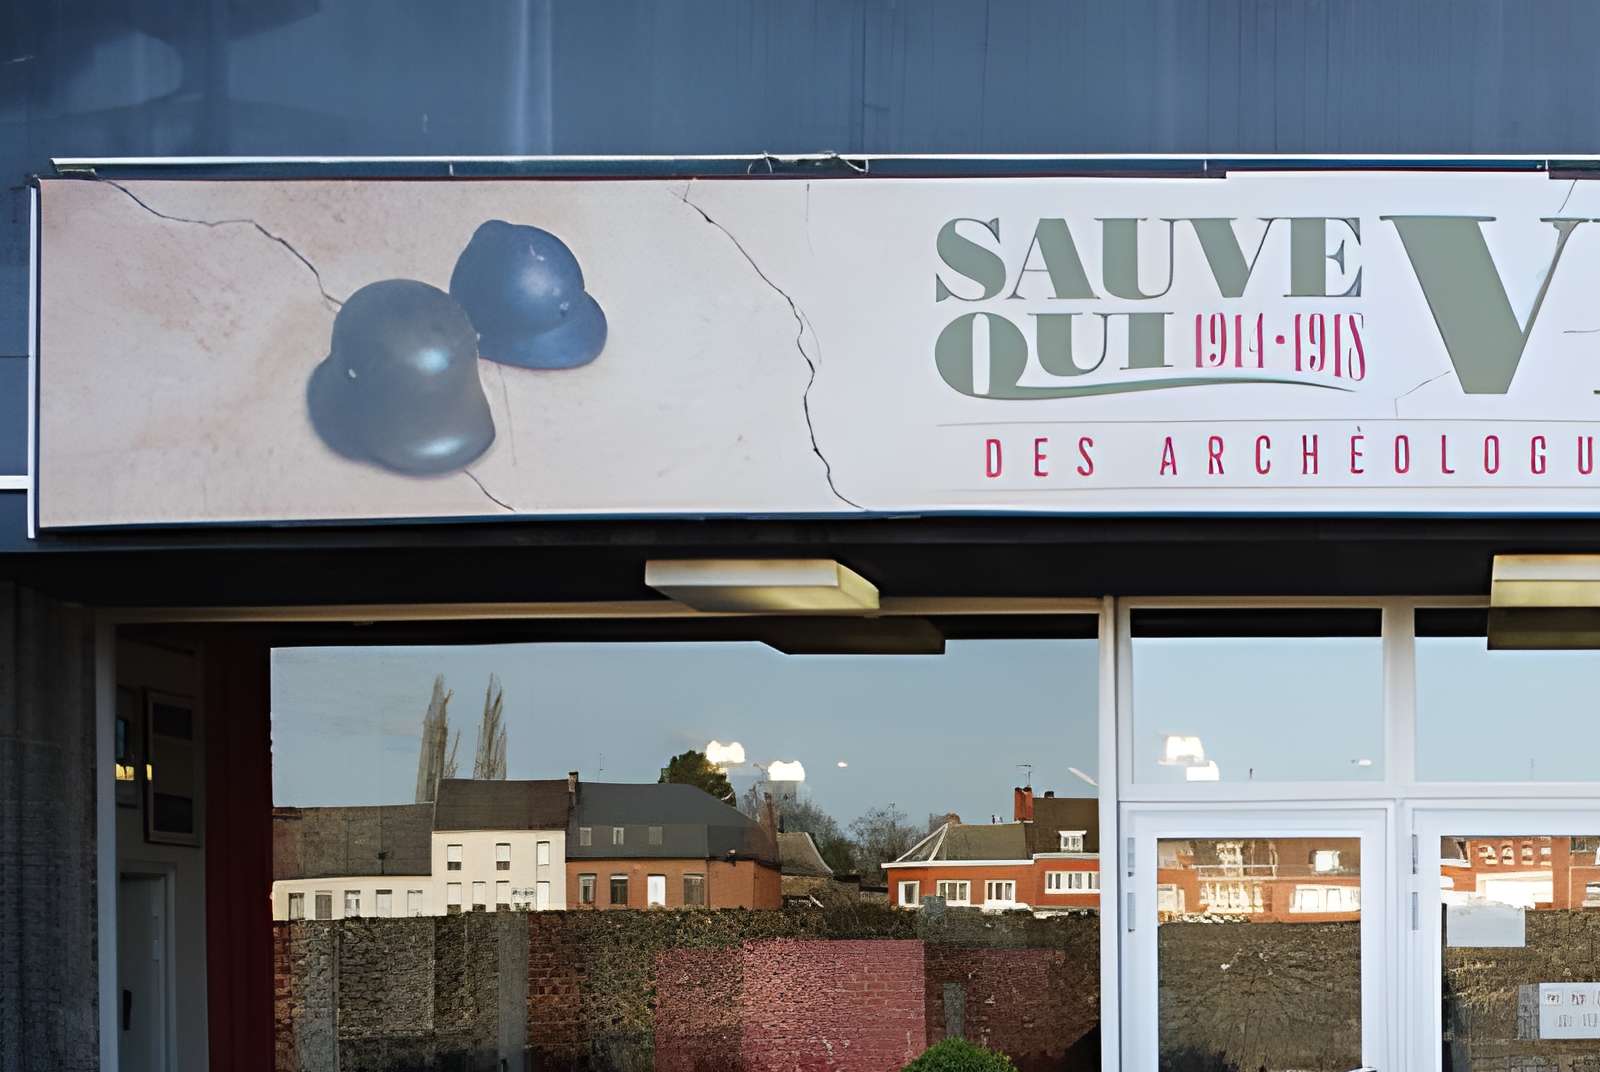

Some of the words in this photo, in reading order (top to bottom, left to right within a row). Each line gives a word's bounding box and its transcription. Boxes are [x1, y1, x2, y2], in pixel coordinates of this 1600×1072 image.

[935, 216, 1362, 302] SAUVE
[934, 311, 1175, 400] QUI
[985, 435, 1095, 479] DES
